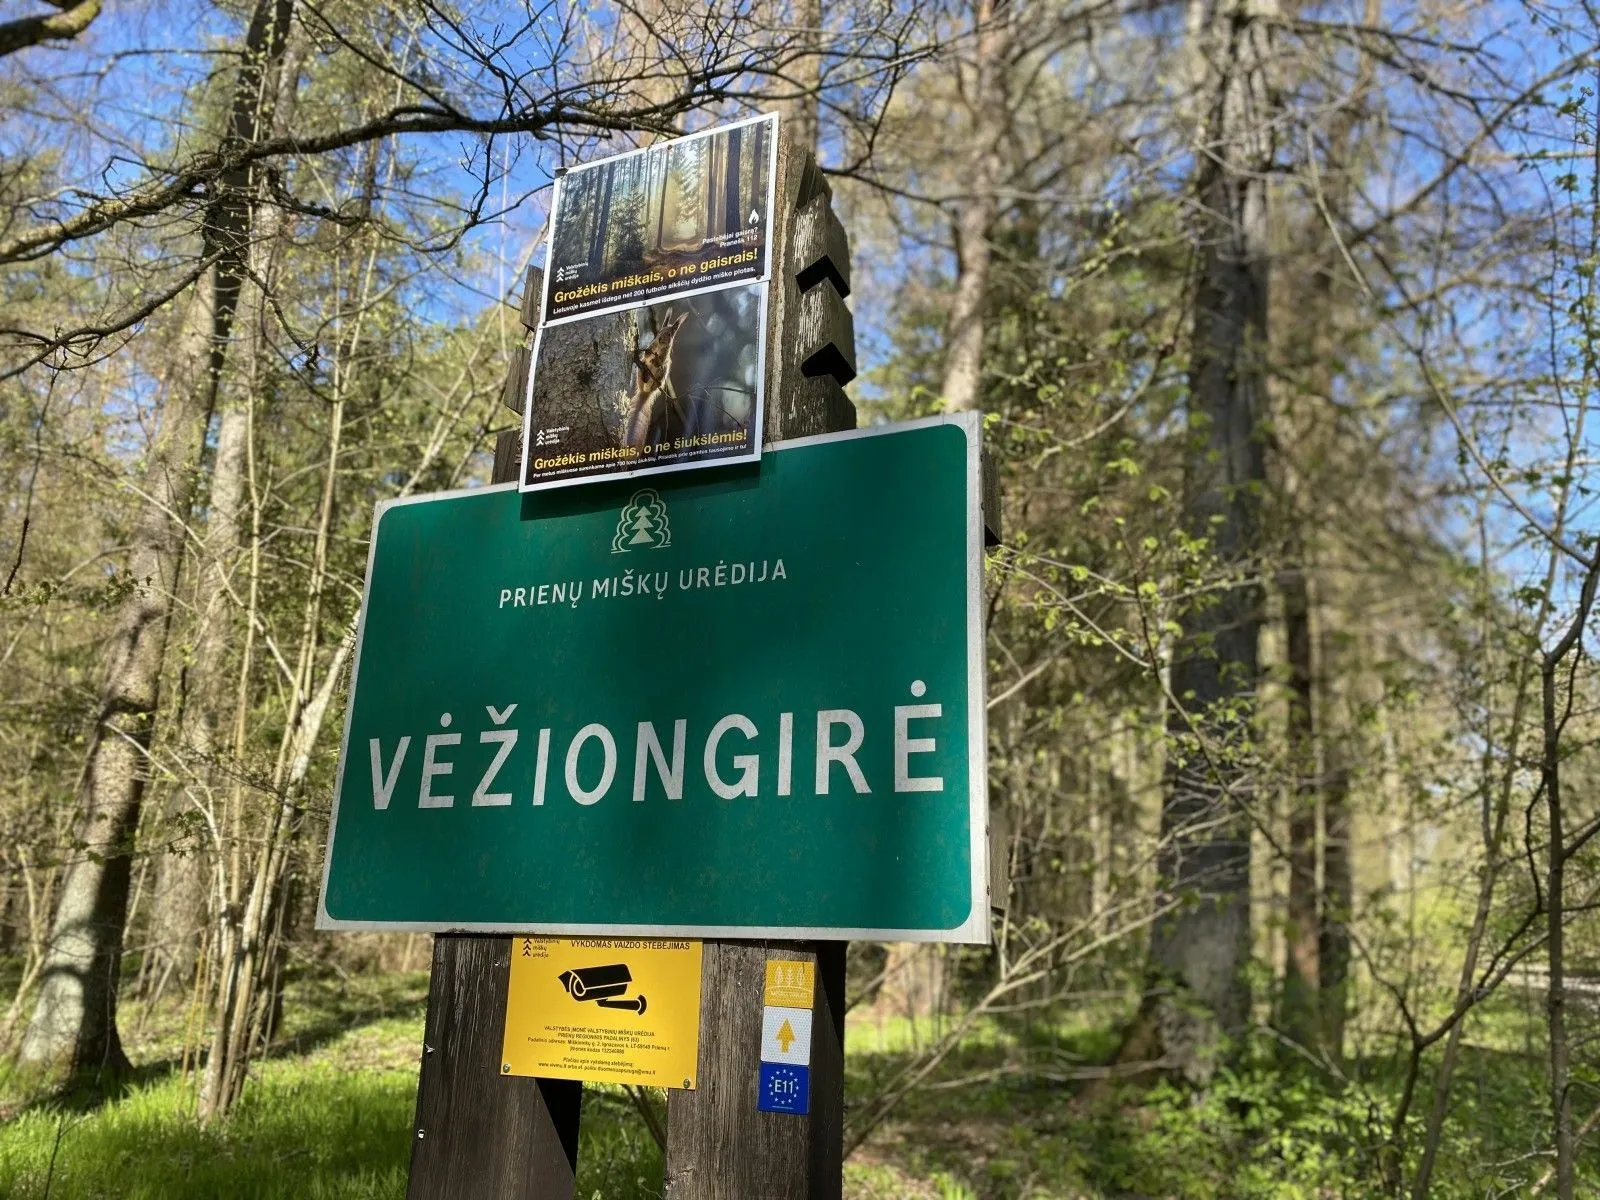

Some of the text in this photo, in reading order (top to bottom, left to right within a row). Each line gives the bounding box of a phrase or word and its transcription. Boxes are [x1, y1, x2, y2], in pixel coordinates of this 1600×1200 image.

[553, 304, 578, 314] Lietuvoje
[580, 298, 600, 308] kasmet
[601, 295, 621, 304] išdega
[646, 285, 667, 294] futbolo
[691, 275, 712, 284] dydžio
[713, 271, 732, 280] miško
[734, 266, 756, 276] plotas.
[554, 248, 758, 303] Grožėkis miškais, o ne gaisrais!
[535, 428, 747, 470] Grožėkis miškais, o ne šiukšlėmis!
[499, 559, 787, 609] PRIENŲ MIŠKŲ URĖDIJA
[368, 678, 944, 810] VĖŽIONGIRĖ
[571, 940, 612, 949] VYKDOMAS
[614, 941, 640, 949] VAIZDO
[774, 1080, 793, 1093] E11
